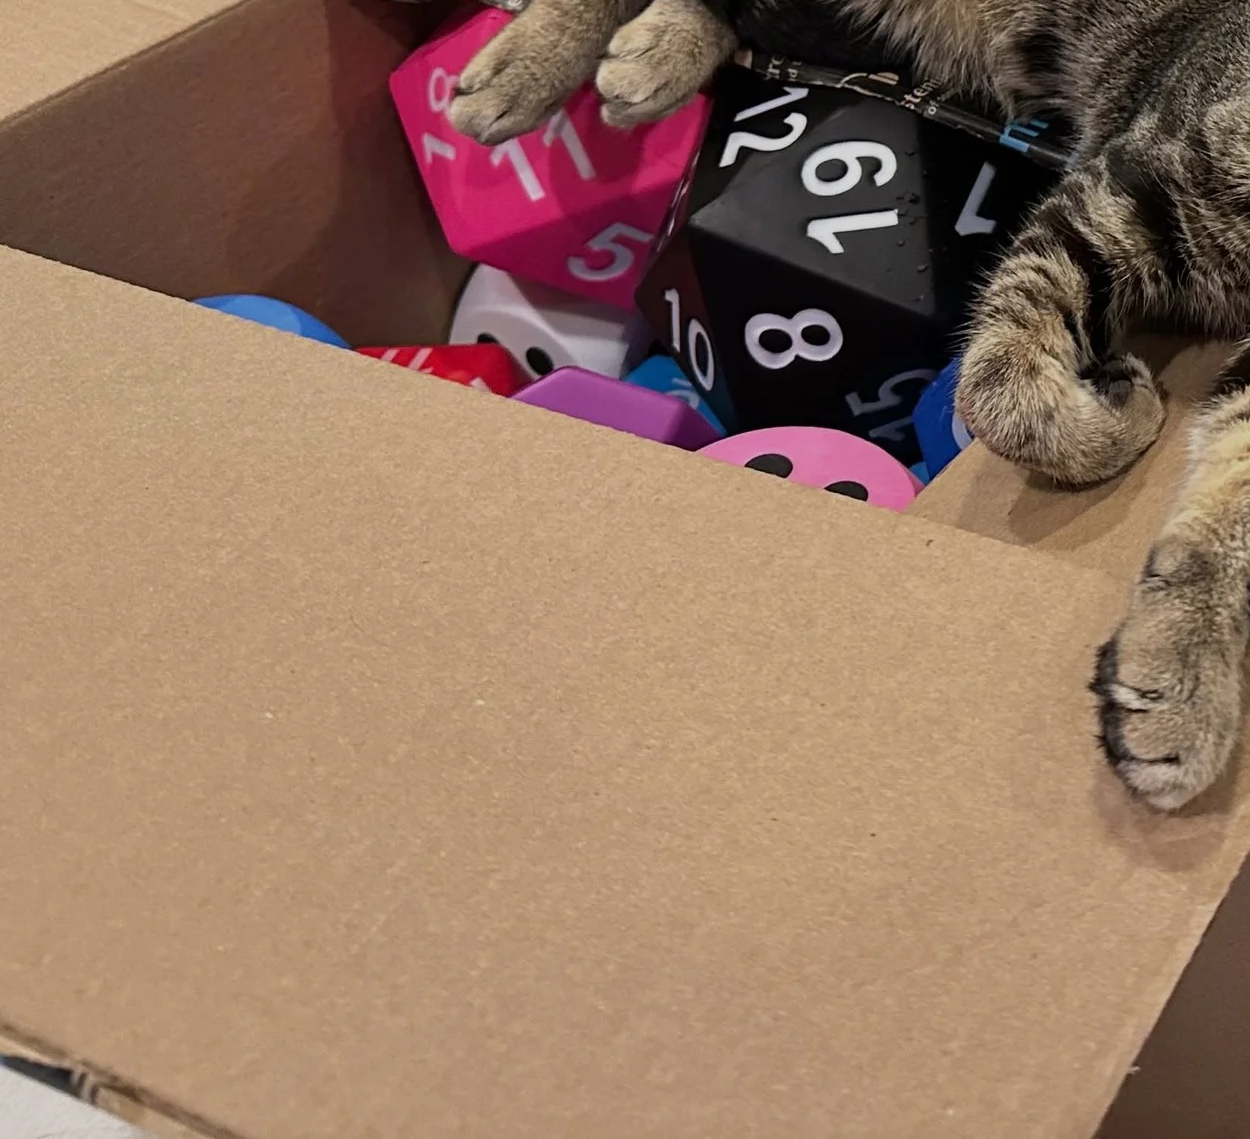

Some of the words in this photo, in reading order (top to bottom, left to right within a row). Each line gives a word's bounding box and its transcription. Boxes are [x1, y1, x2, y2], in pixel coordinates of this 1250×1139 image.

[490, 108, 596, 201] 11
[718, 86, 809, 167] 12
[801, 140, 899, 254] 19
[568, 222, 654, 281] 5
[665, 287, 714, 391] 10
[744, 308, 844, 369] 8
